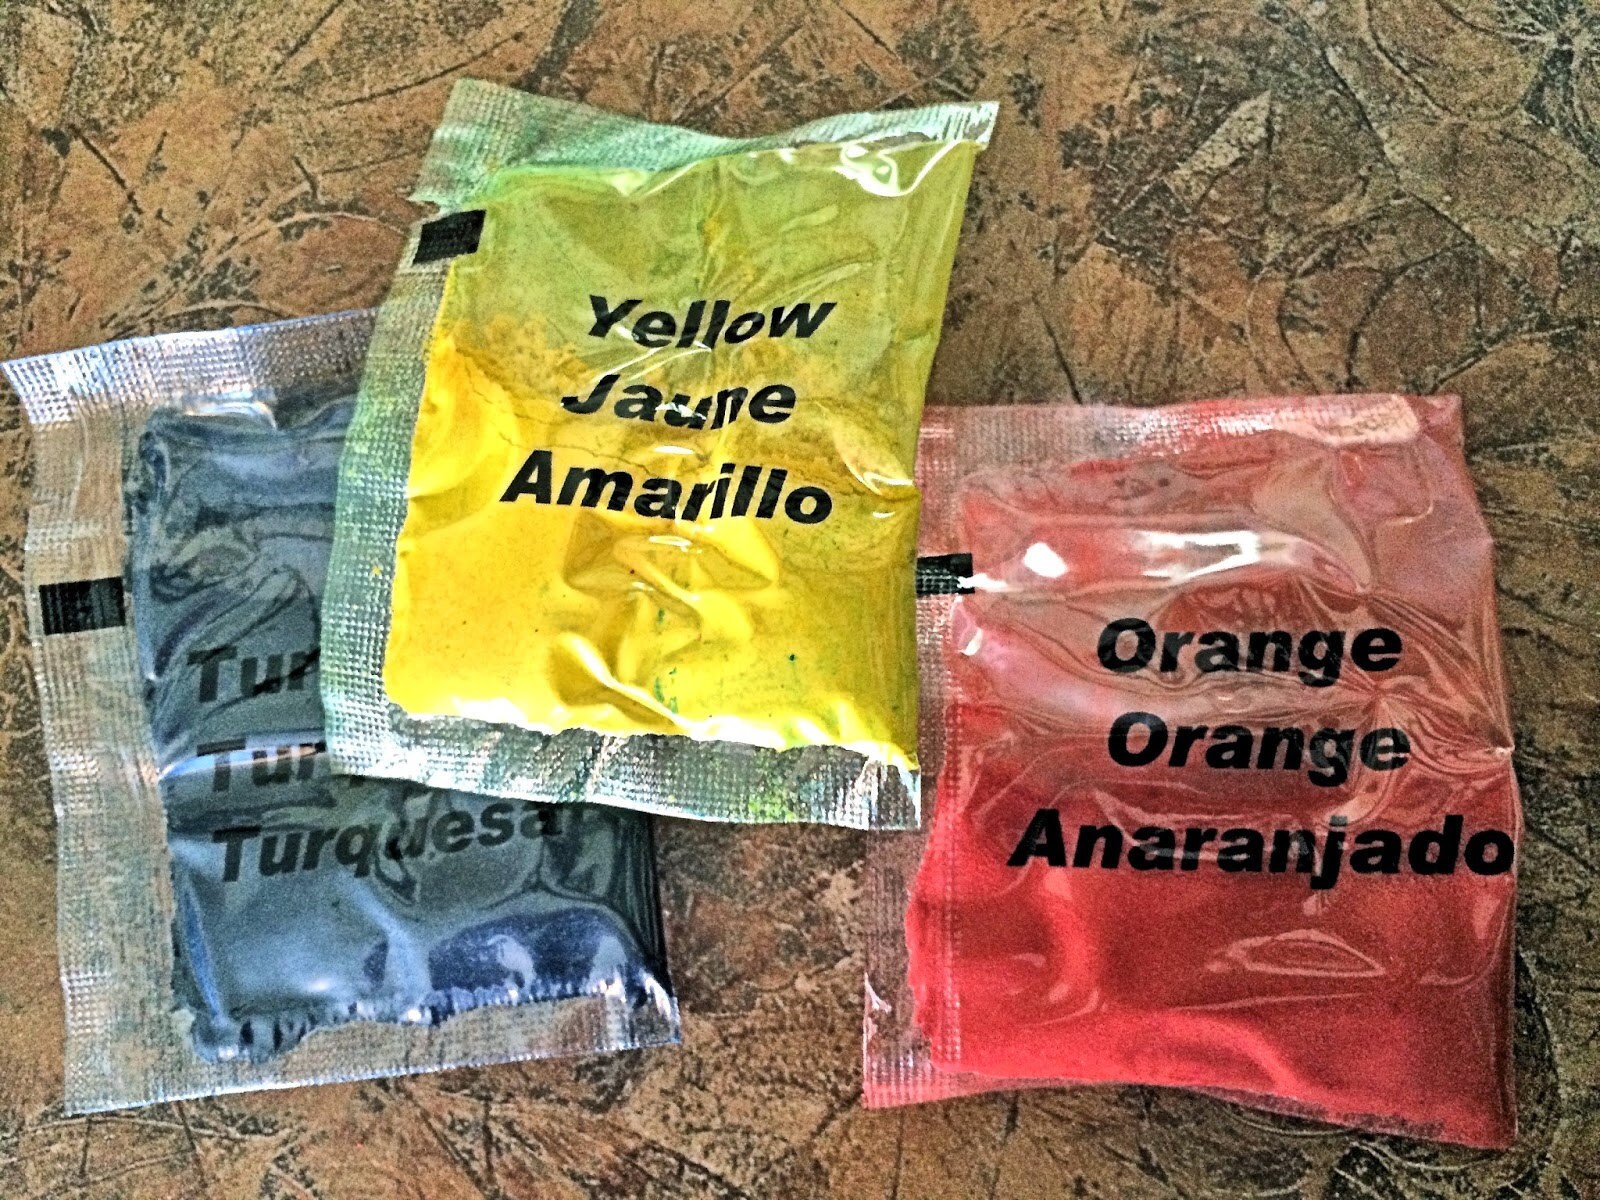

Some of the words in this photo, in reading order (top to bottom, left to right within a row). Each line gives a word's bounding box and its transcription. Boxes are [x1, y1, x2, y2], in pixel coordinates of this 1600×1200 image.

[588, 294, 837, 349] Yellow
[560, 373, 796, 430] Jaune
[499, 449, 833, 525] Amarillo
[1097, 617, 1403, 687] Orange
[1107, 711, 1411, 788] Orange
[213, 801, 563, 883] Turquesa
[1007, 808, 1515, 890] Anaranjado
